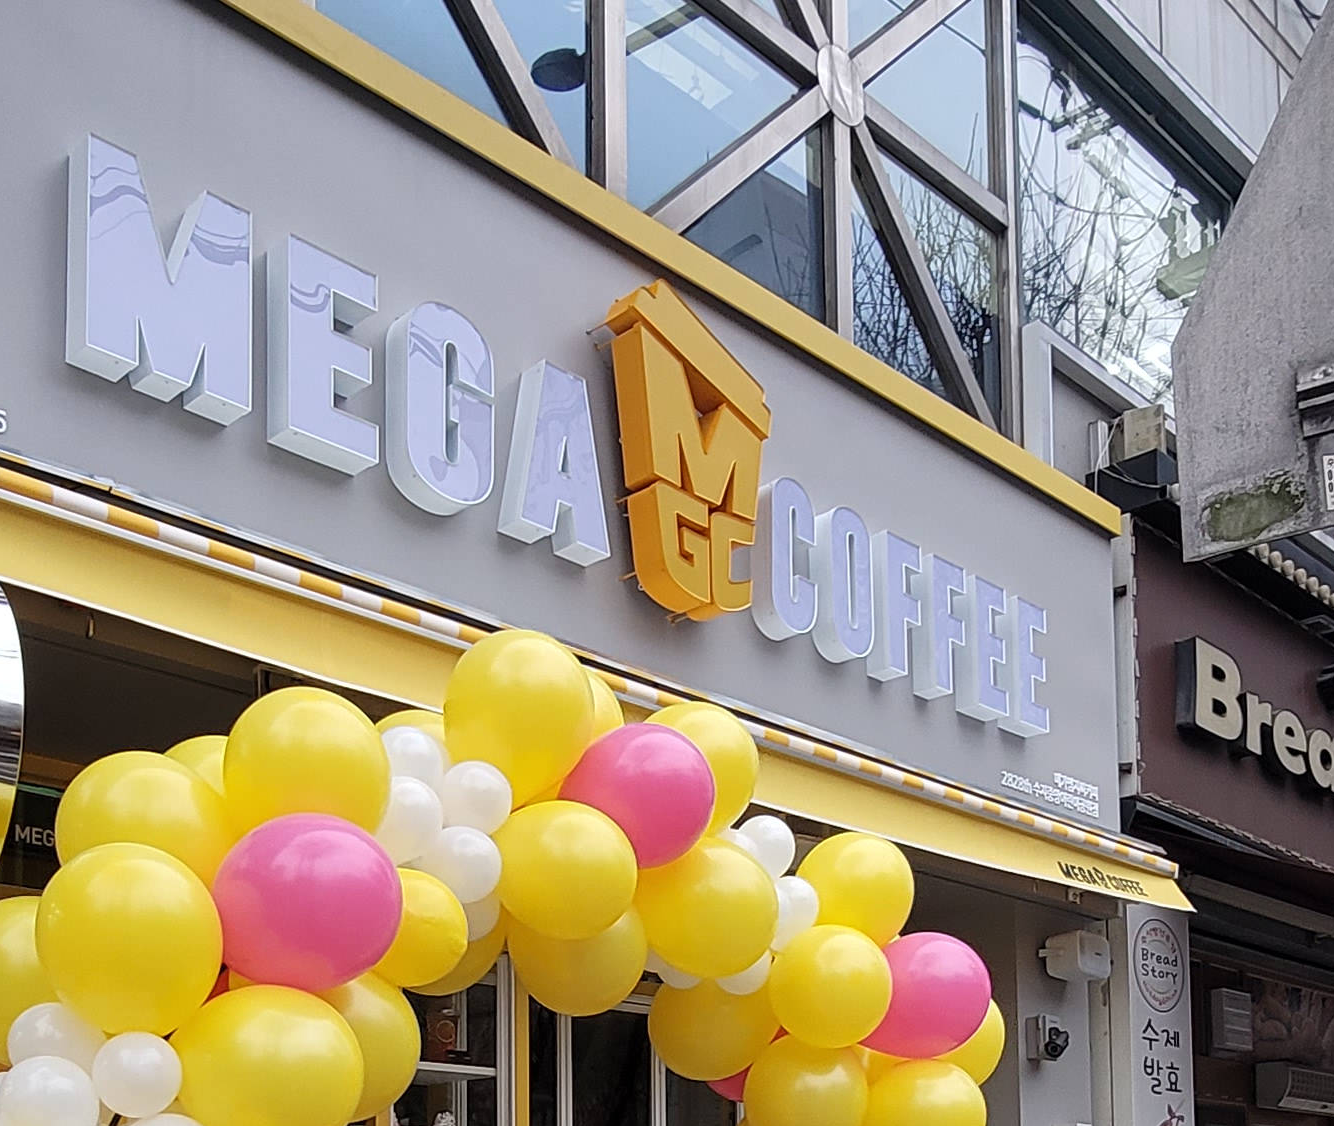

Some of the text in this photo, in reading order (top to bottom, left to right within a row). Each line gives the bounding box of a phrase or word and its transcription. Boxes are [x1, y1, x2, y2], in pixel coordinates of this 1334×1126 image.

[67, 133, 611, 567] MEGA
[753, 476, 1051, 738] COFFEE
[1141, 947, 1178, 968] Bread
[1141, 962, 1178, 986] Story
[1141, 1018, 1181, 1051] 수제
[1143, 1056, 1183, 1095] 발효
